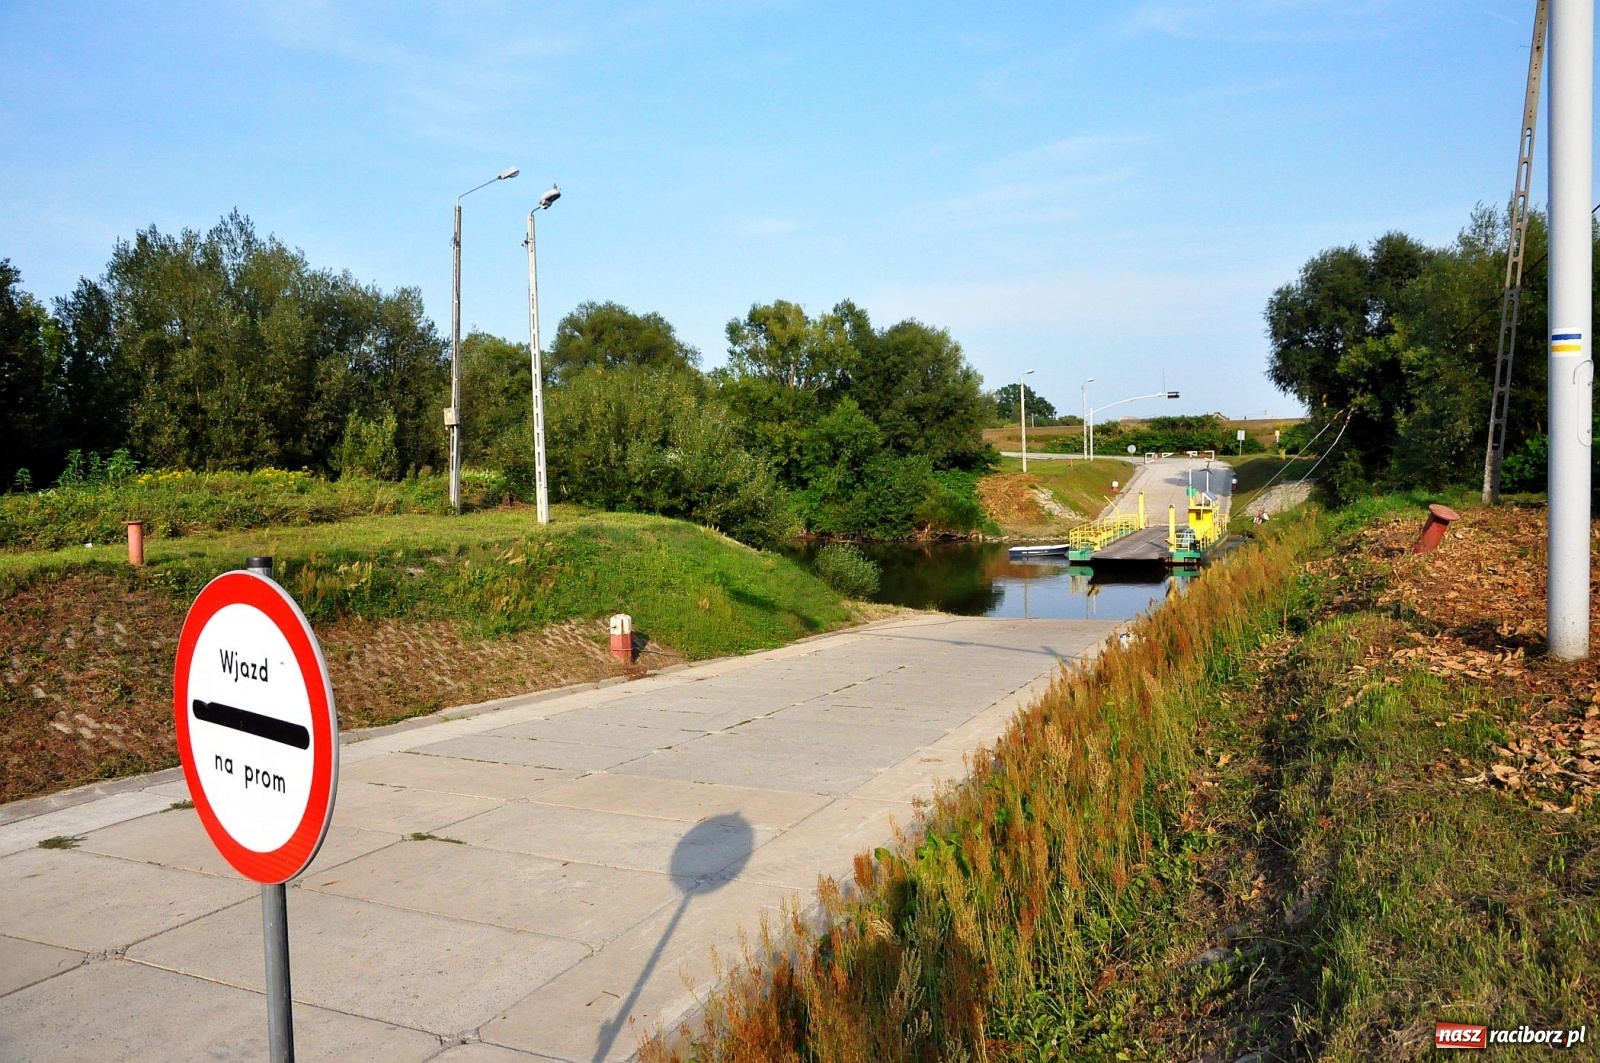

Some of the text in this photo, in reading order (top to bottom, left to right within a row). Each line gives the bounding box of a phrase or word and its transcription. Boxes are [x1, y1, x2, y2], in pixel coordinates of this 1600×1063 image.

[219, 648, 269, 682] Wjazd
[215, 754, 286, 793] na prom
